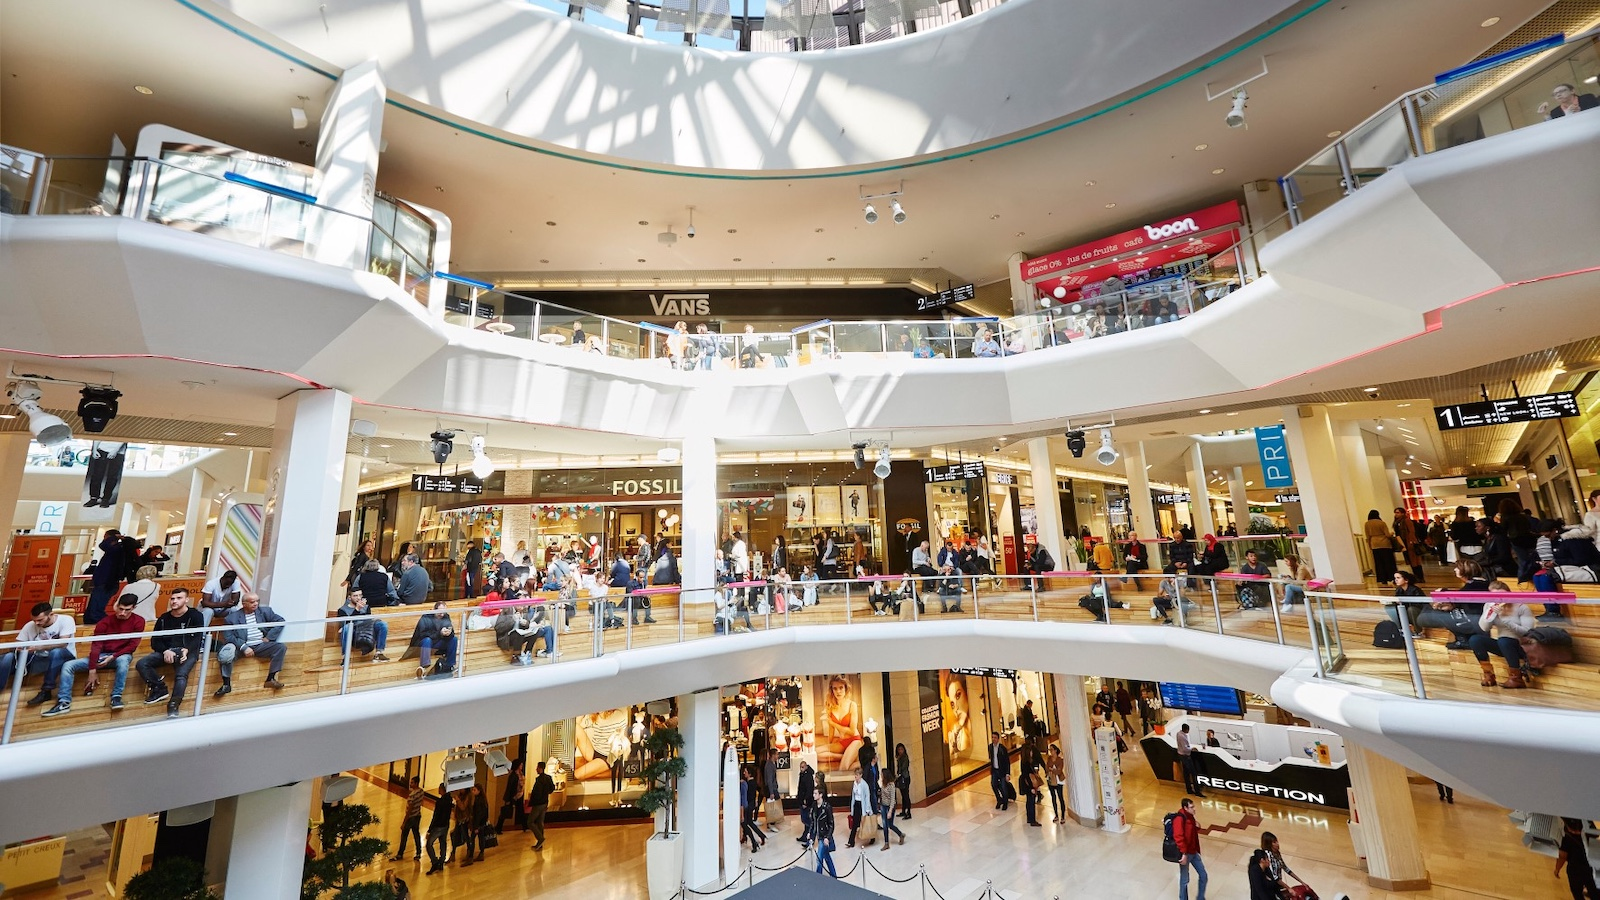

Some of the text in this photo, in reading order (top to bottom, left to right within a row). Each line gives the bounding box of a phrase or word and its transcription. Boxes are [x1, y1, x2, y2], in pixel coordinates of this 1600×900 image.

[1144, 217, 1200, 241] boon
[1027, 264, 1049, 276] glace
[1049, 259, 1062, 269] 0%
[1066, 255, 1081, 266] jus
[1081, 250, 1092, 260] de
[1093, 243, 1119, 257] fruits
[1124, 236, 1143, 248] café
[649, 294, 710, 316] VANS
[918, 298, 926, 311] 2
[1440, 408, 1454, 427] 1
[415, 476, 422, 490] 1
[925, 469, 933, 482] 1
[612, 479, 683, 496] FOSSIL
[922, 718, 941, 733] WEEK
[1196, 775, 1325, 804] RECEPTION
[34, 842, 61, 854] CREUX
